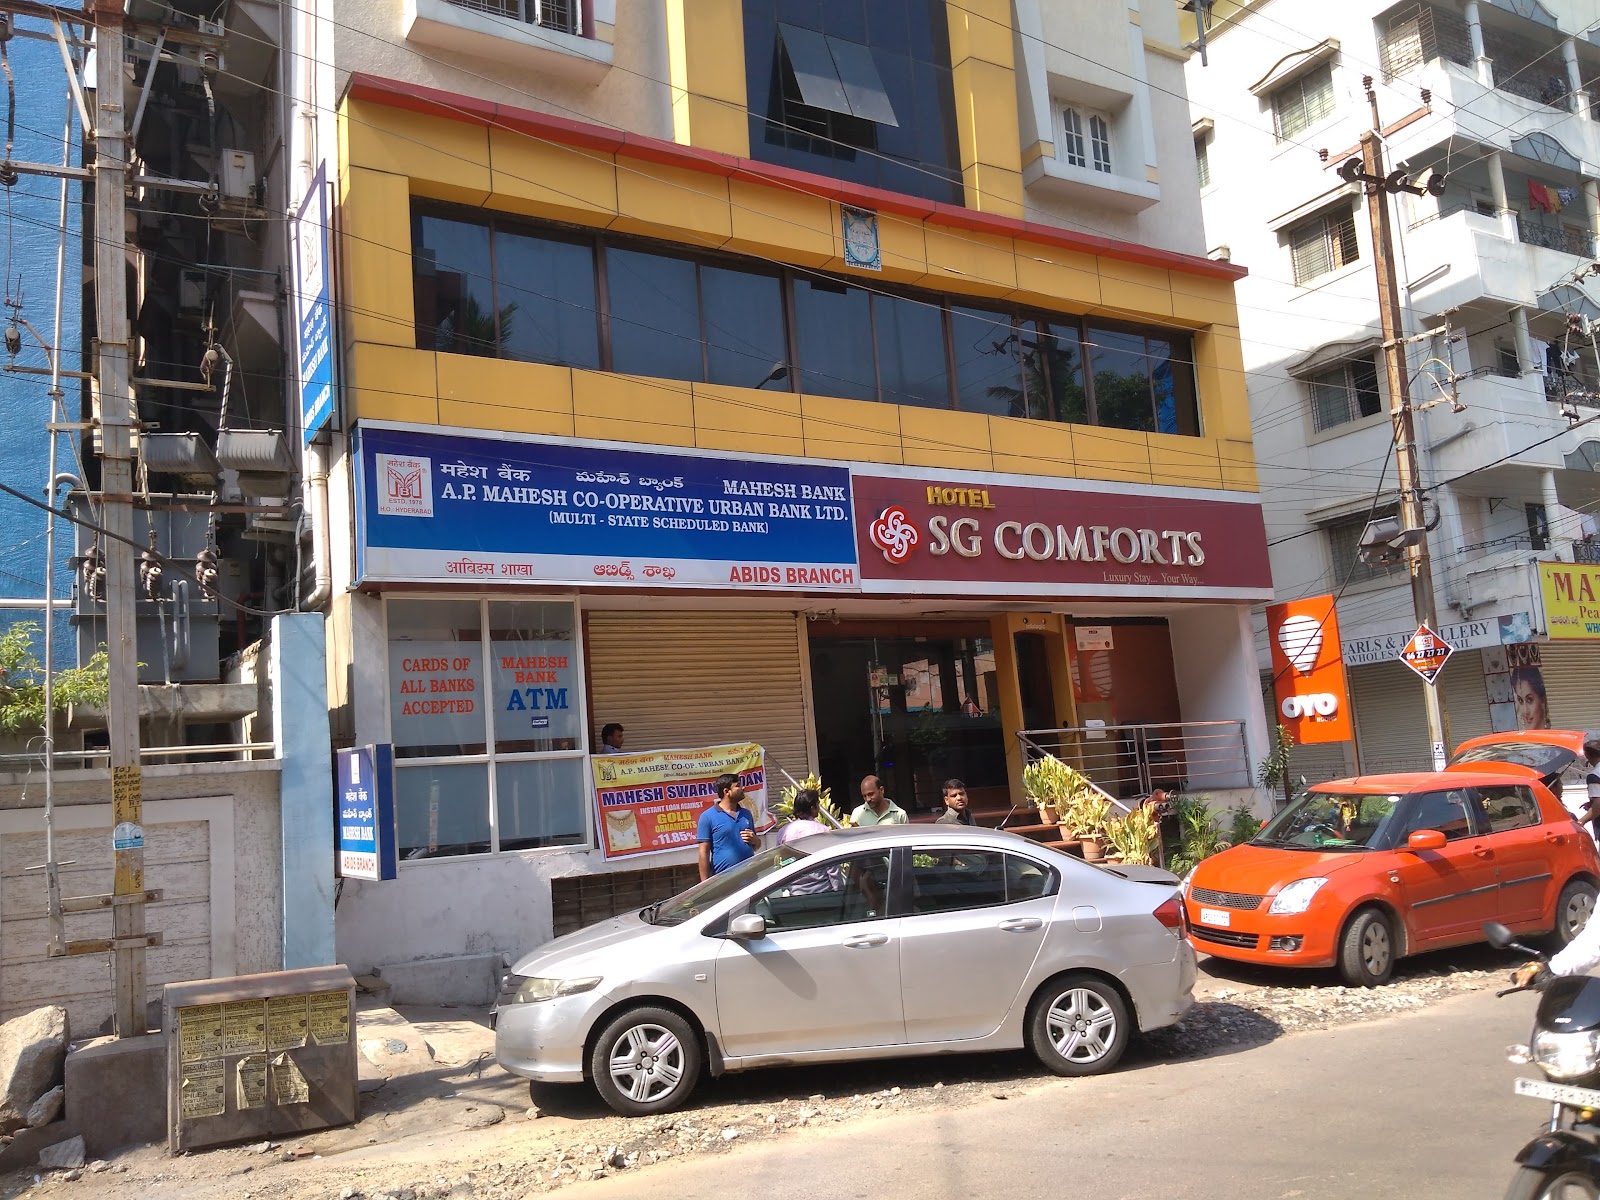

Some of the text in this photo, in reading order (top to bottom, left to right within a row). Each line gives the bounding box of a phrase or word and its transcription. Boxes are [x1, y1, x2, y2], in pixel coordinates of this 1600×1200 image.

[387, 458, 406, 468] महेश
[440, 460, 532, 483] महेश बैंक
[575, 471, 684, 491] మహేశ్ బ్యాంక్
[723, 479, 846, 502] MAHESH BANK
[926, 486, 996, 510] HOTEL
[441, 482, 849, 522] A.P. MAHESH CO-OPERATIVE URBAN BANK LTD.
[549, 510, 596, 526] (MULTI
[607, 514, 650, 528] STATE
[652, 516, 730, 532] SCHEDULED
[732, 520, 770, 534] BANK)
[929, 514, 1206, 568] SG COMFORTS
[501, 564, 534, 576] शाखा
[594, 561, 676, 580] ఆబిడ్స్ శాఖ
[730, 566, 854, 585] ABIDS BRANCH
[1103, 572, 1132, 584] Luxury
[1160, 573, 1179, 584] Your
[1386, 636, 1396, 650] &
[402, 658, 471, 672] CARDS OF
[502, 656, 569, 669] MAHESH
[514, 671, 558, 684] BANK
[400, 678, 475, 694] ALL BANKS
[402, 700, 474, 715] ACCEPTED
[506, 688, 568, 711] ATM
[1282, 692, 1338, 719] OYO
[637, 764, 669, 773] MAHESH
[699, 759, 725, 768] URBAN
[726, 757, 745, 765] BANK
[602, 787, 664, 807] MAHESH
[640, 805, 666, 815] INSTANT
[681, 801, 704, 811] AGAINST
[657, 811, 692, 824] GOLD
[342, 826, 374, 840] MAHESH BANK
[655, 821, 698, 834] ORNAMENTS
[344, 856, 375, 871] ABIDS BRANCH
